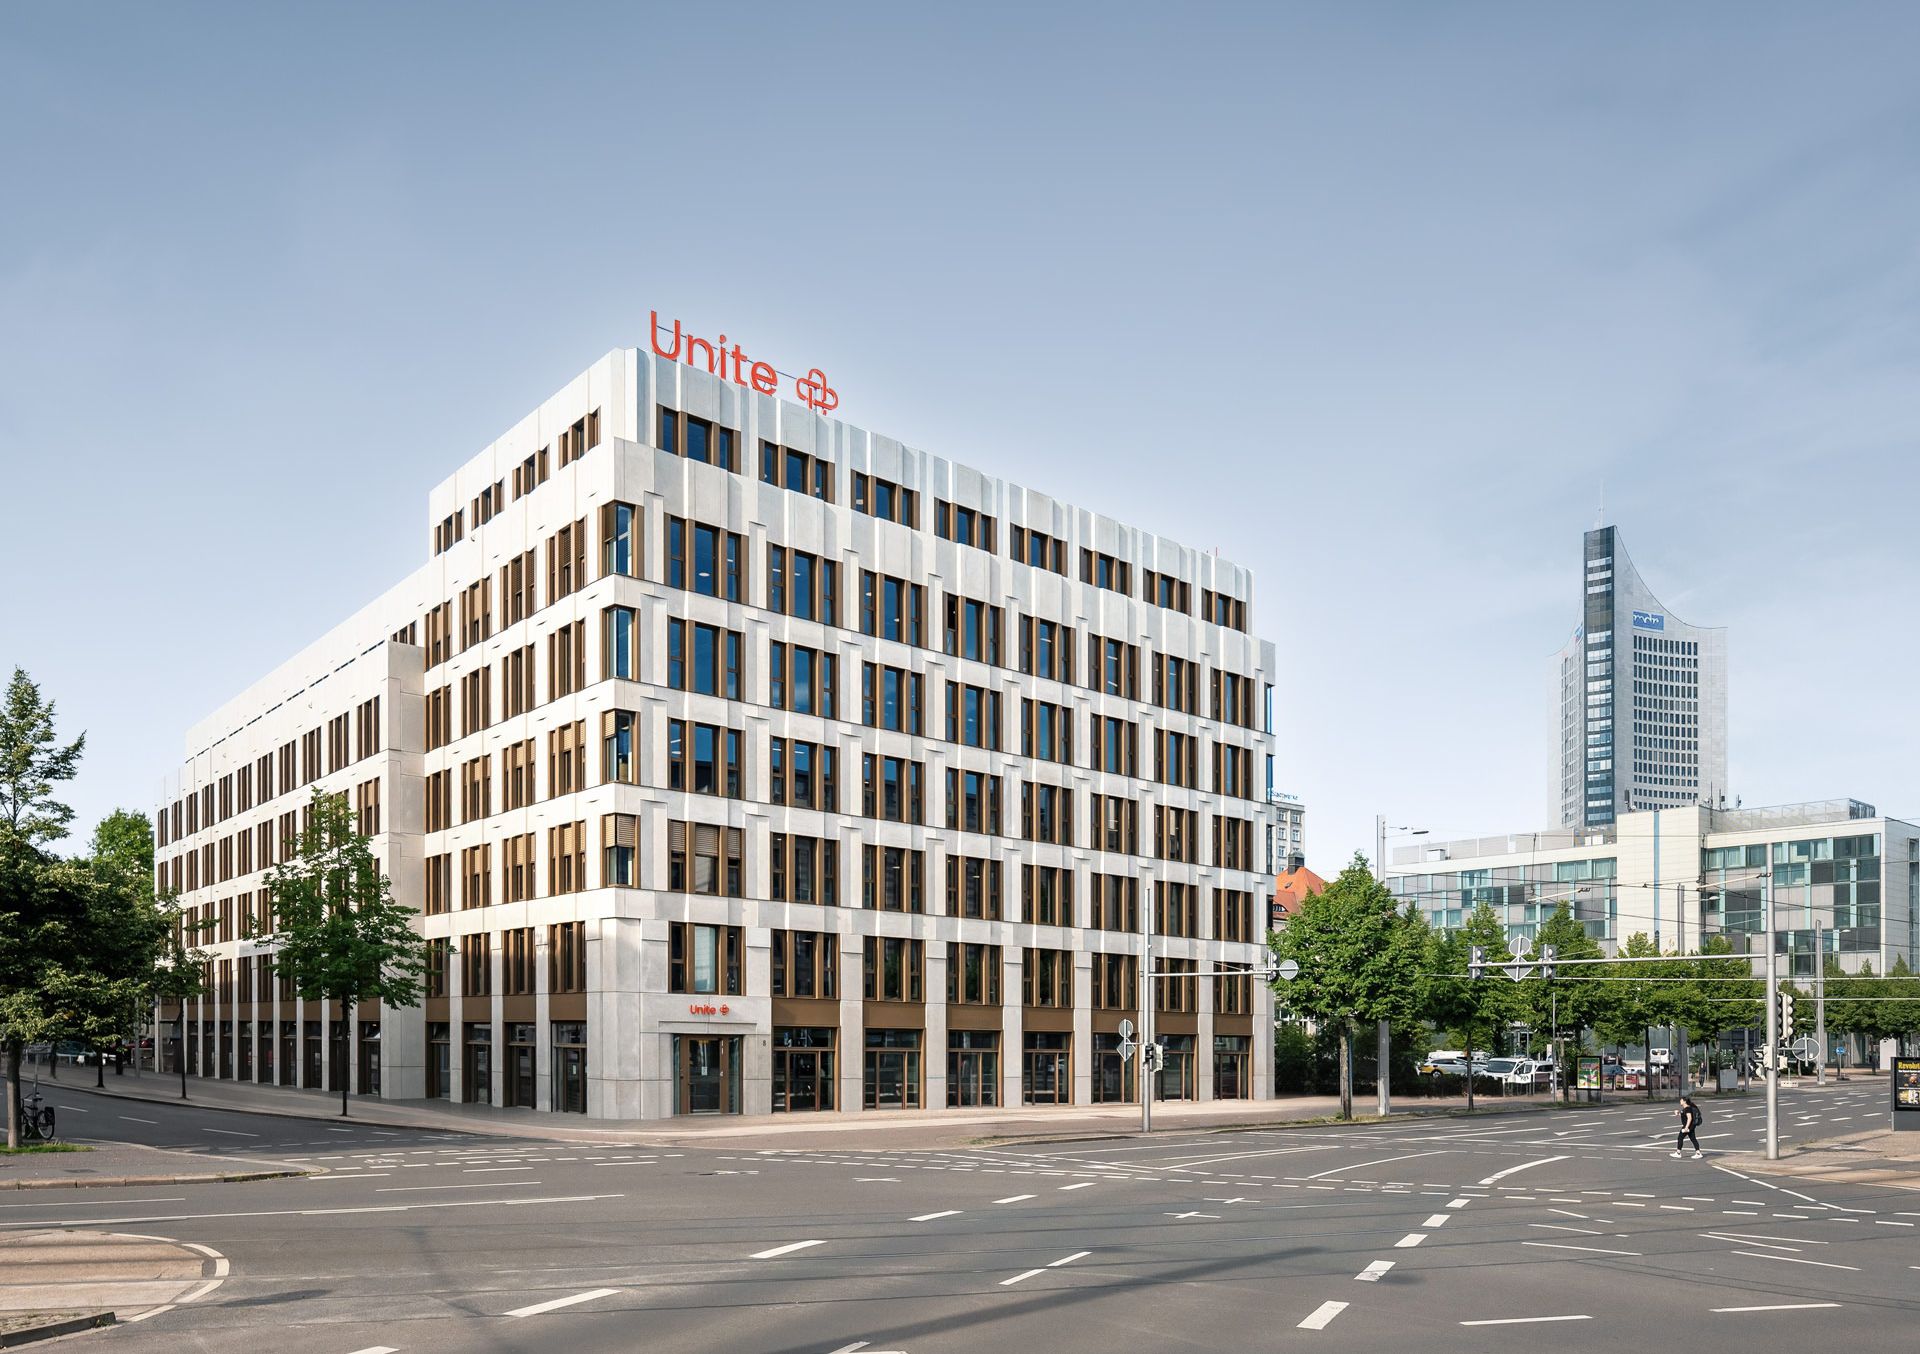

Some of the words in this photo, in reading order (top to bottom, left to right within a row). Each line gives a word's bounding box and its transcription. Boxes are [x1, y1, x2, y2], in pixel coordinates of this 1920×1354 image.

[650, 310, 778, 396] Unite
[1633, 613, 1659, 624] mdr
[690, 1004, 716, 1015] Unite
